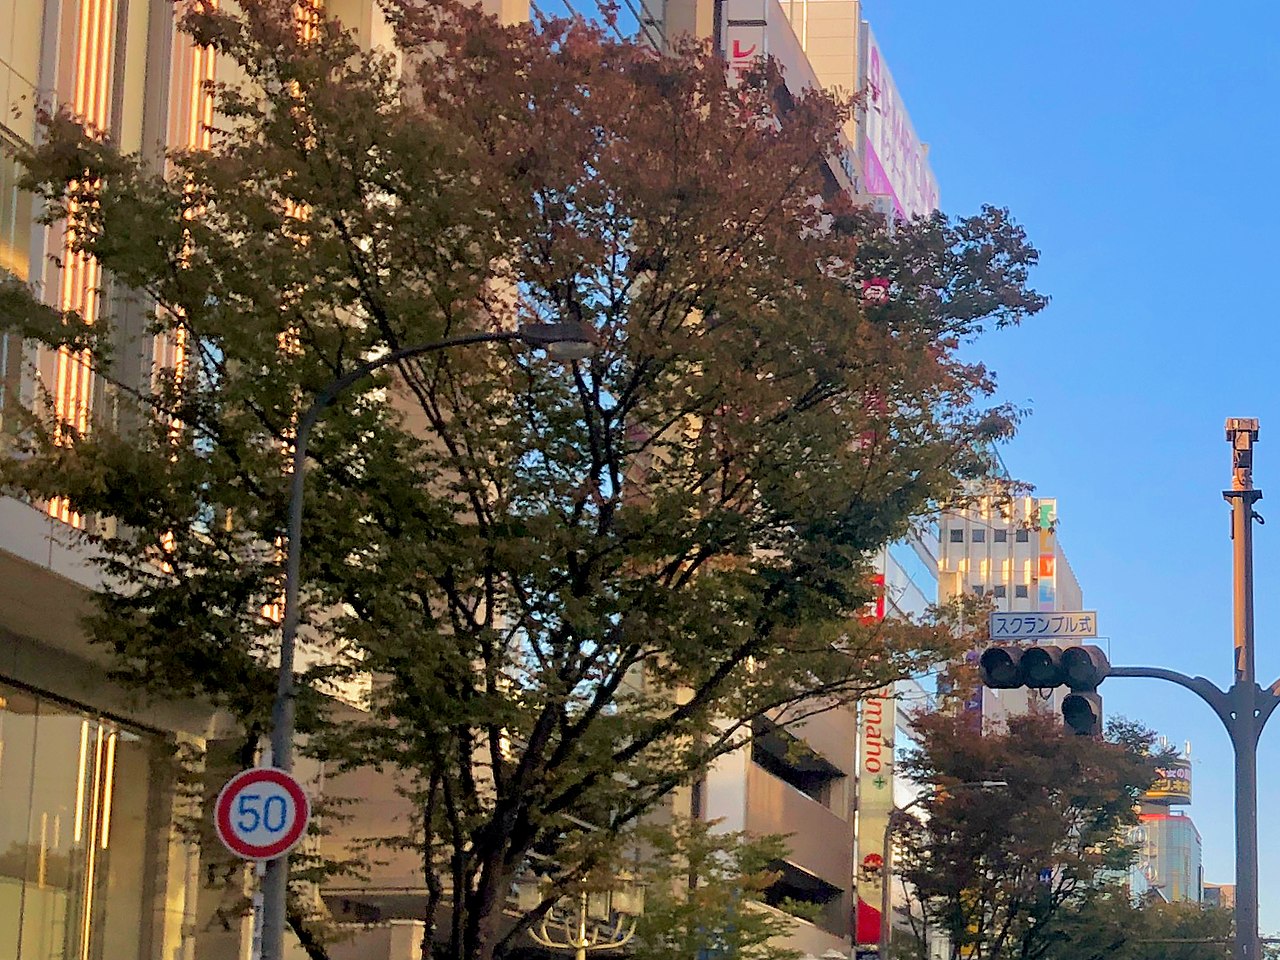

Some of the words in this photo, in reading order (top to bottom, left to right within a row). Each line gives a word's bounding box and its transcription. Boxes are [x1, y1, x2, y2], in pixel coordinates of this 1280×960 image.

[995, 615, 1093, 635] スクランブル式
[237, 794, 288, 833] 50
